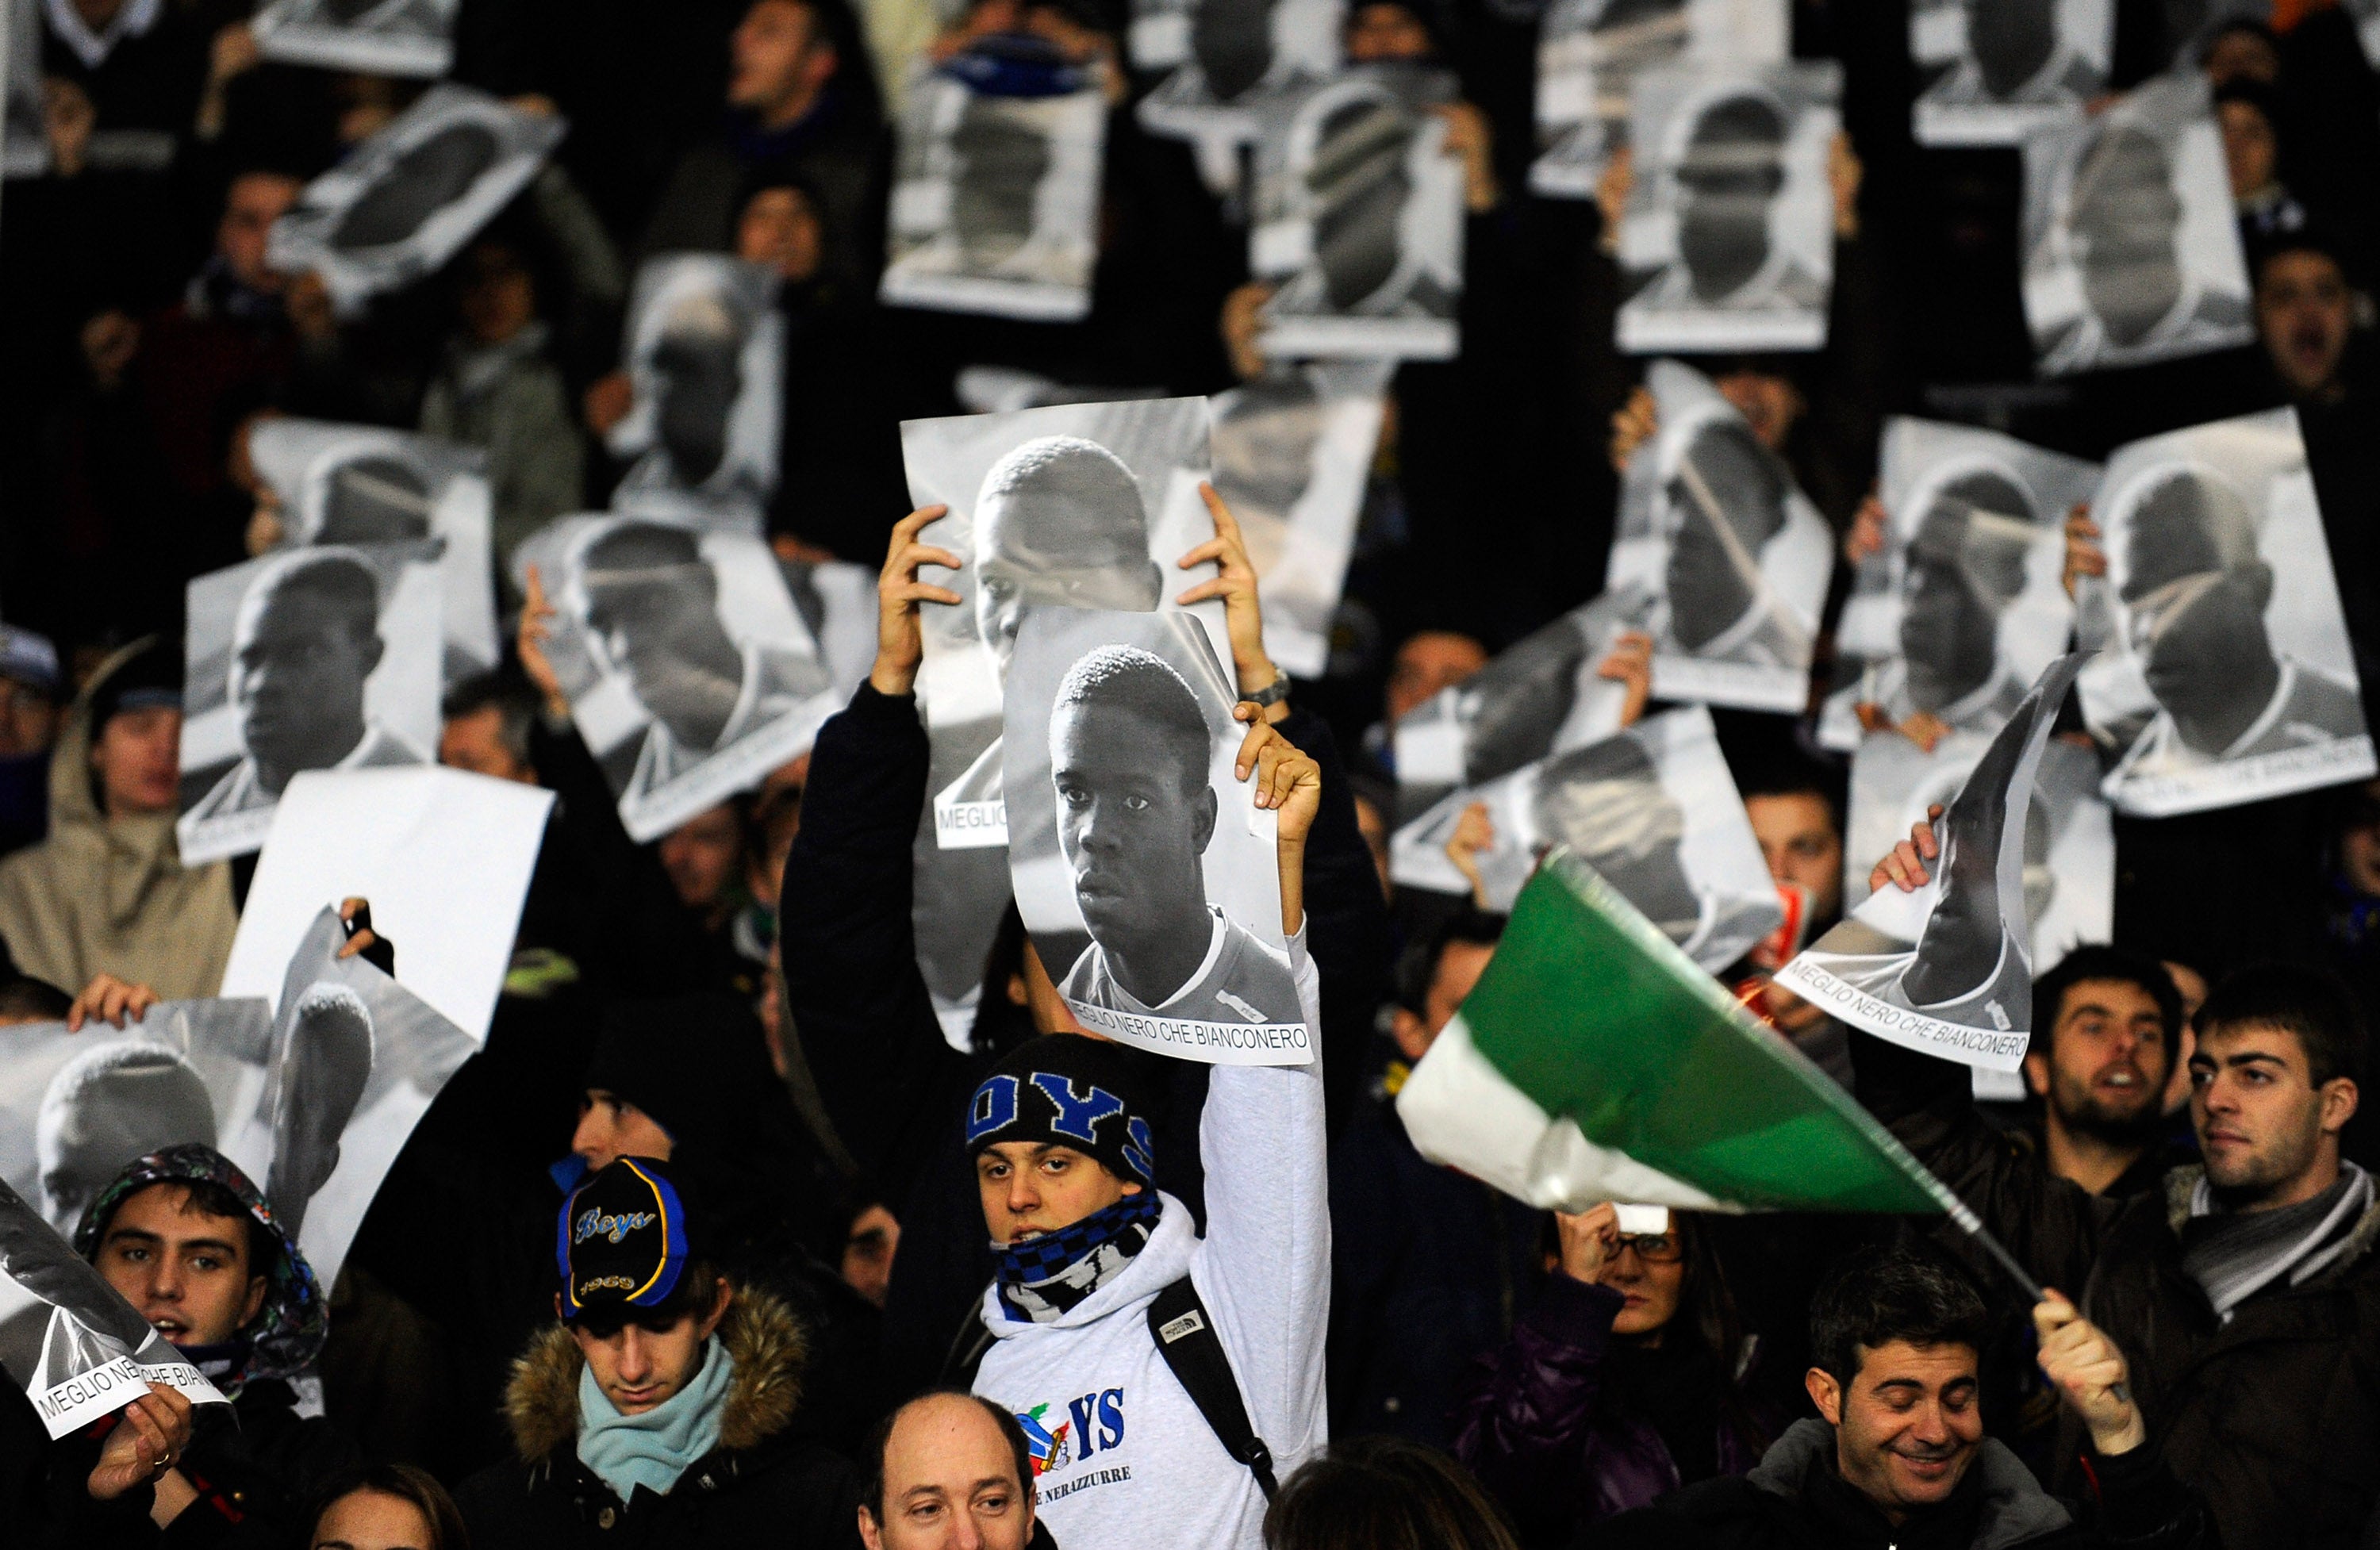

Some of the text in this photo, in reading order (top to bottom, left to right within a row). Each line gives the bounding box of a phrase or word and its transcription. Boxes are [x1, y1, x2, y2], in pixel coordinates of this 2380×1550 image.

[1788, 960, 2027, 1057] MEGLIO NERO CHE BIANCONERO
[1115, 1015, 1157, 1038] NERO
[1160, 1022, 1192, 1044] CHE
[1196, 1025, 1307, 1049] BIANCONERO
[575, 1207, 656, 1245] Boys
[580, 1276, 635, 1296] 1969
[38, 1372, 112, 1419] MEGLIO
[1046, 1466, 1131, 1504] NERAZZURRE
